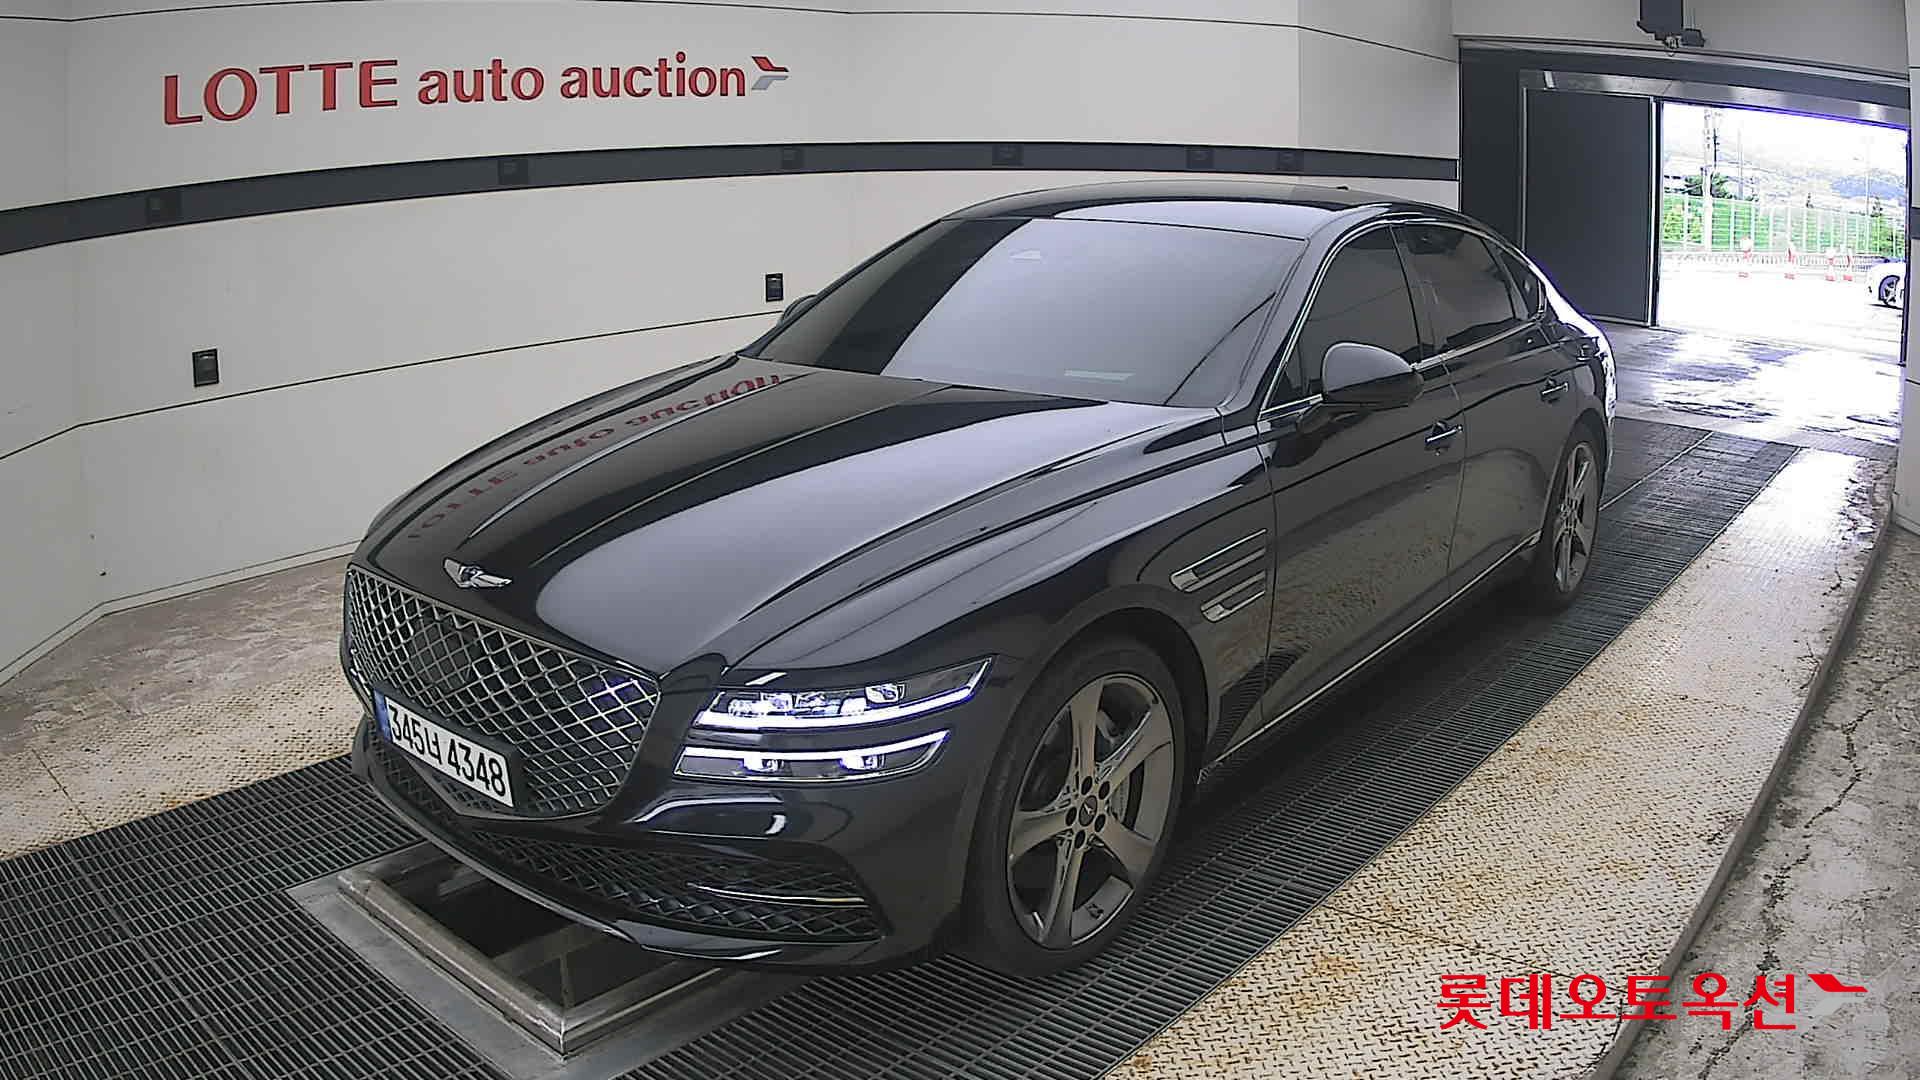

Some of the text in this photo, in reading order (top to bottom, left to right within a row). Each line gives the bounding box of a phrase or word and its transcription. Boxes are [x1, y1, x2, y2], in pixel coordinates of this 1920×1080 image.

[163, 52, 746, 125] LOTTE auto auction
[388, 704, 506, 797] 345너 4348
